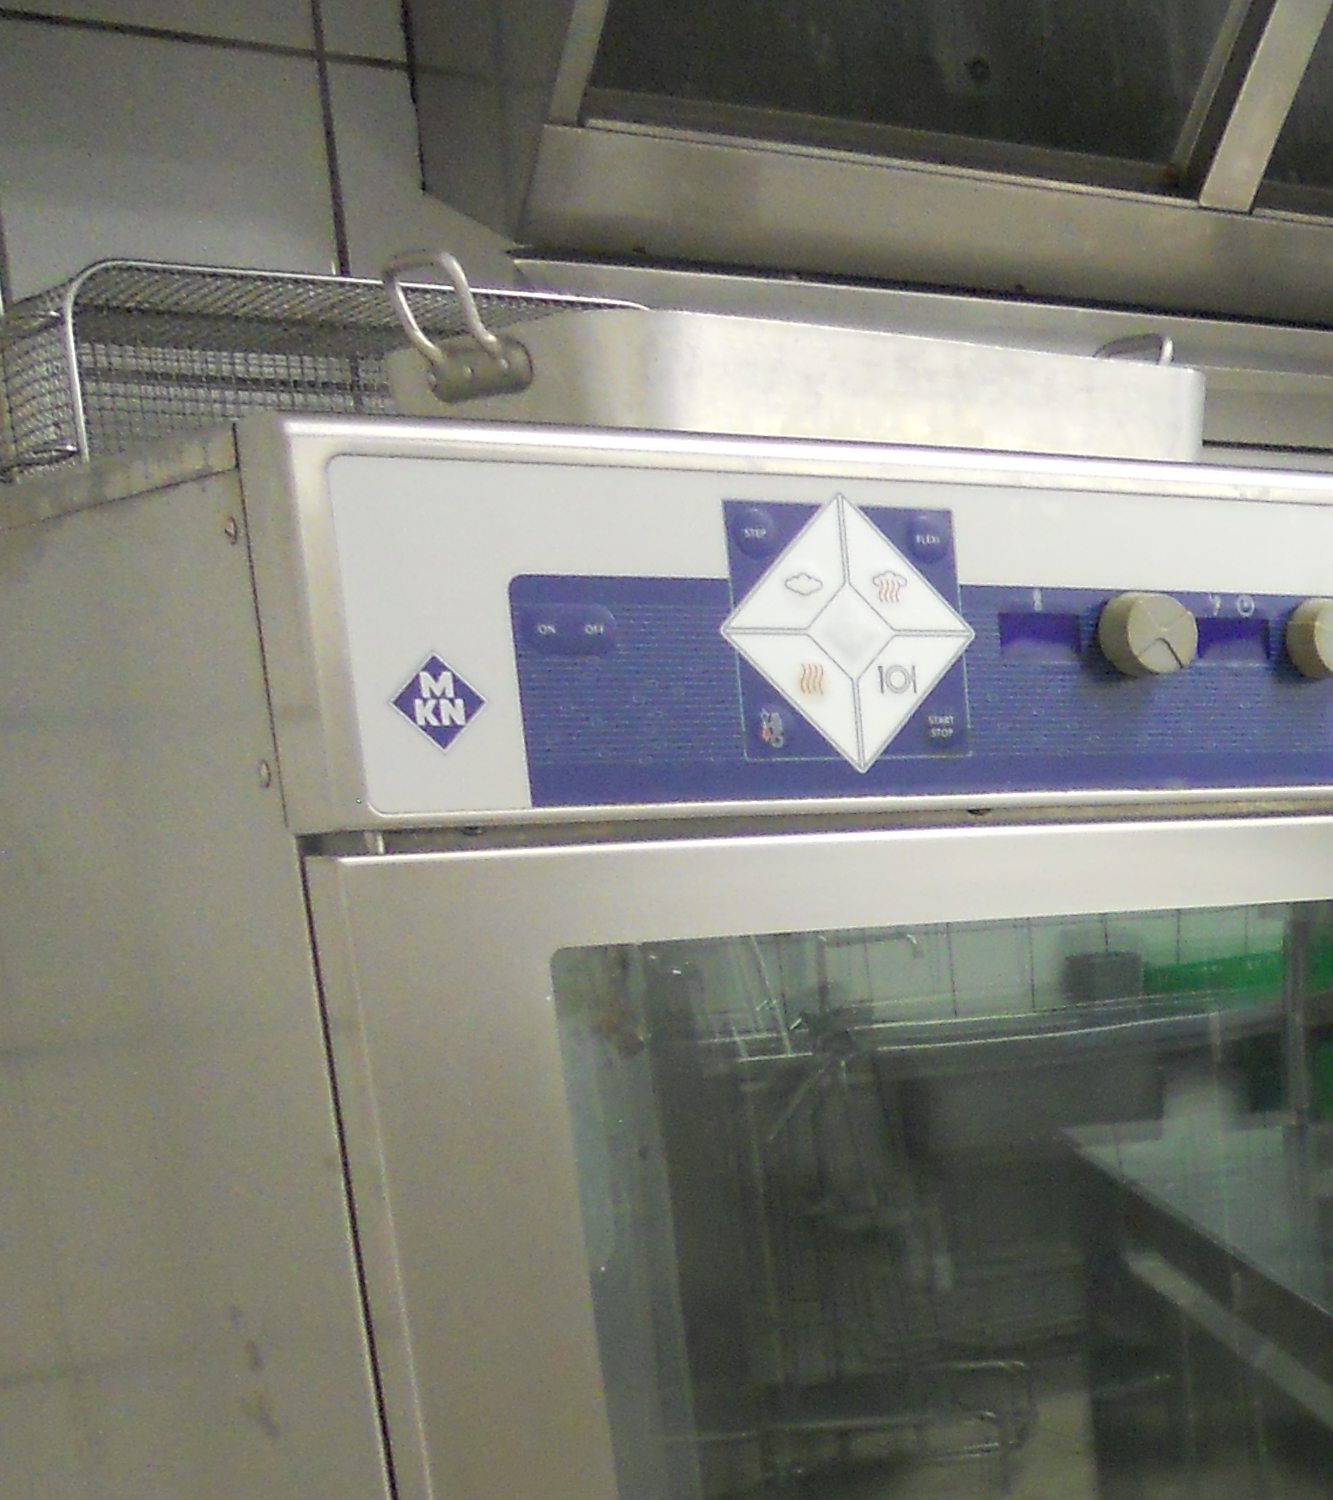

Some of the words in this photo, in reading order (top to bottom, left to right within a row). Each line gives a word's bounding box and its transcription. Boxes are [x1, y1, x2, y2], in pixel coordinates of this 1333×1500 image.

[743, 527, 767, 538] STEP
[536, 623, 557, 635] ON
[583, 623, 605, 636] OFF
[927, 715, 956, 727] START
[929, 727, 955, 739] STOP
